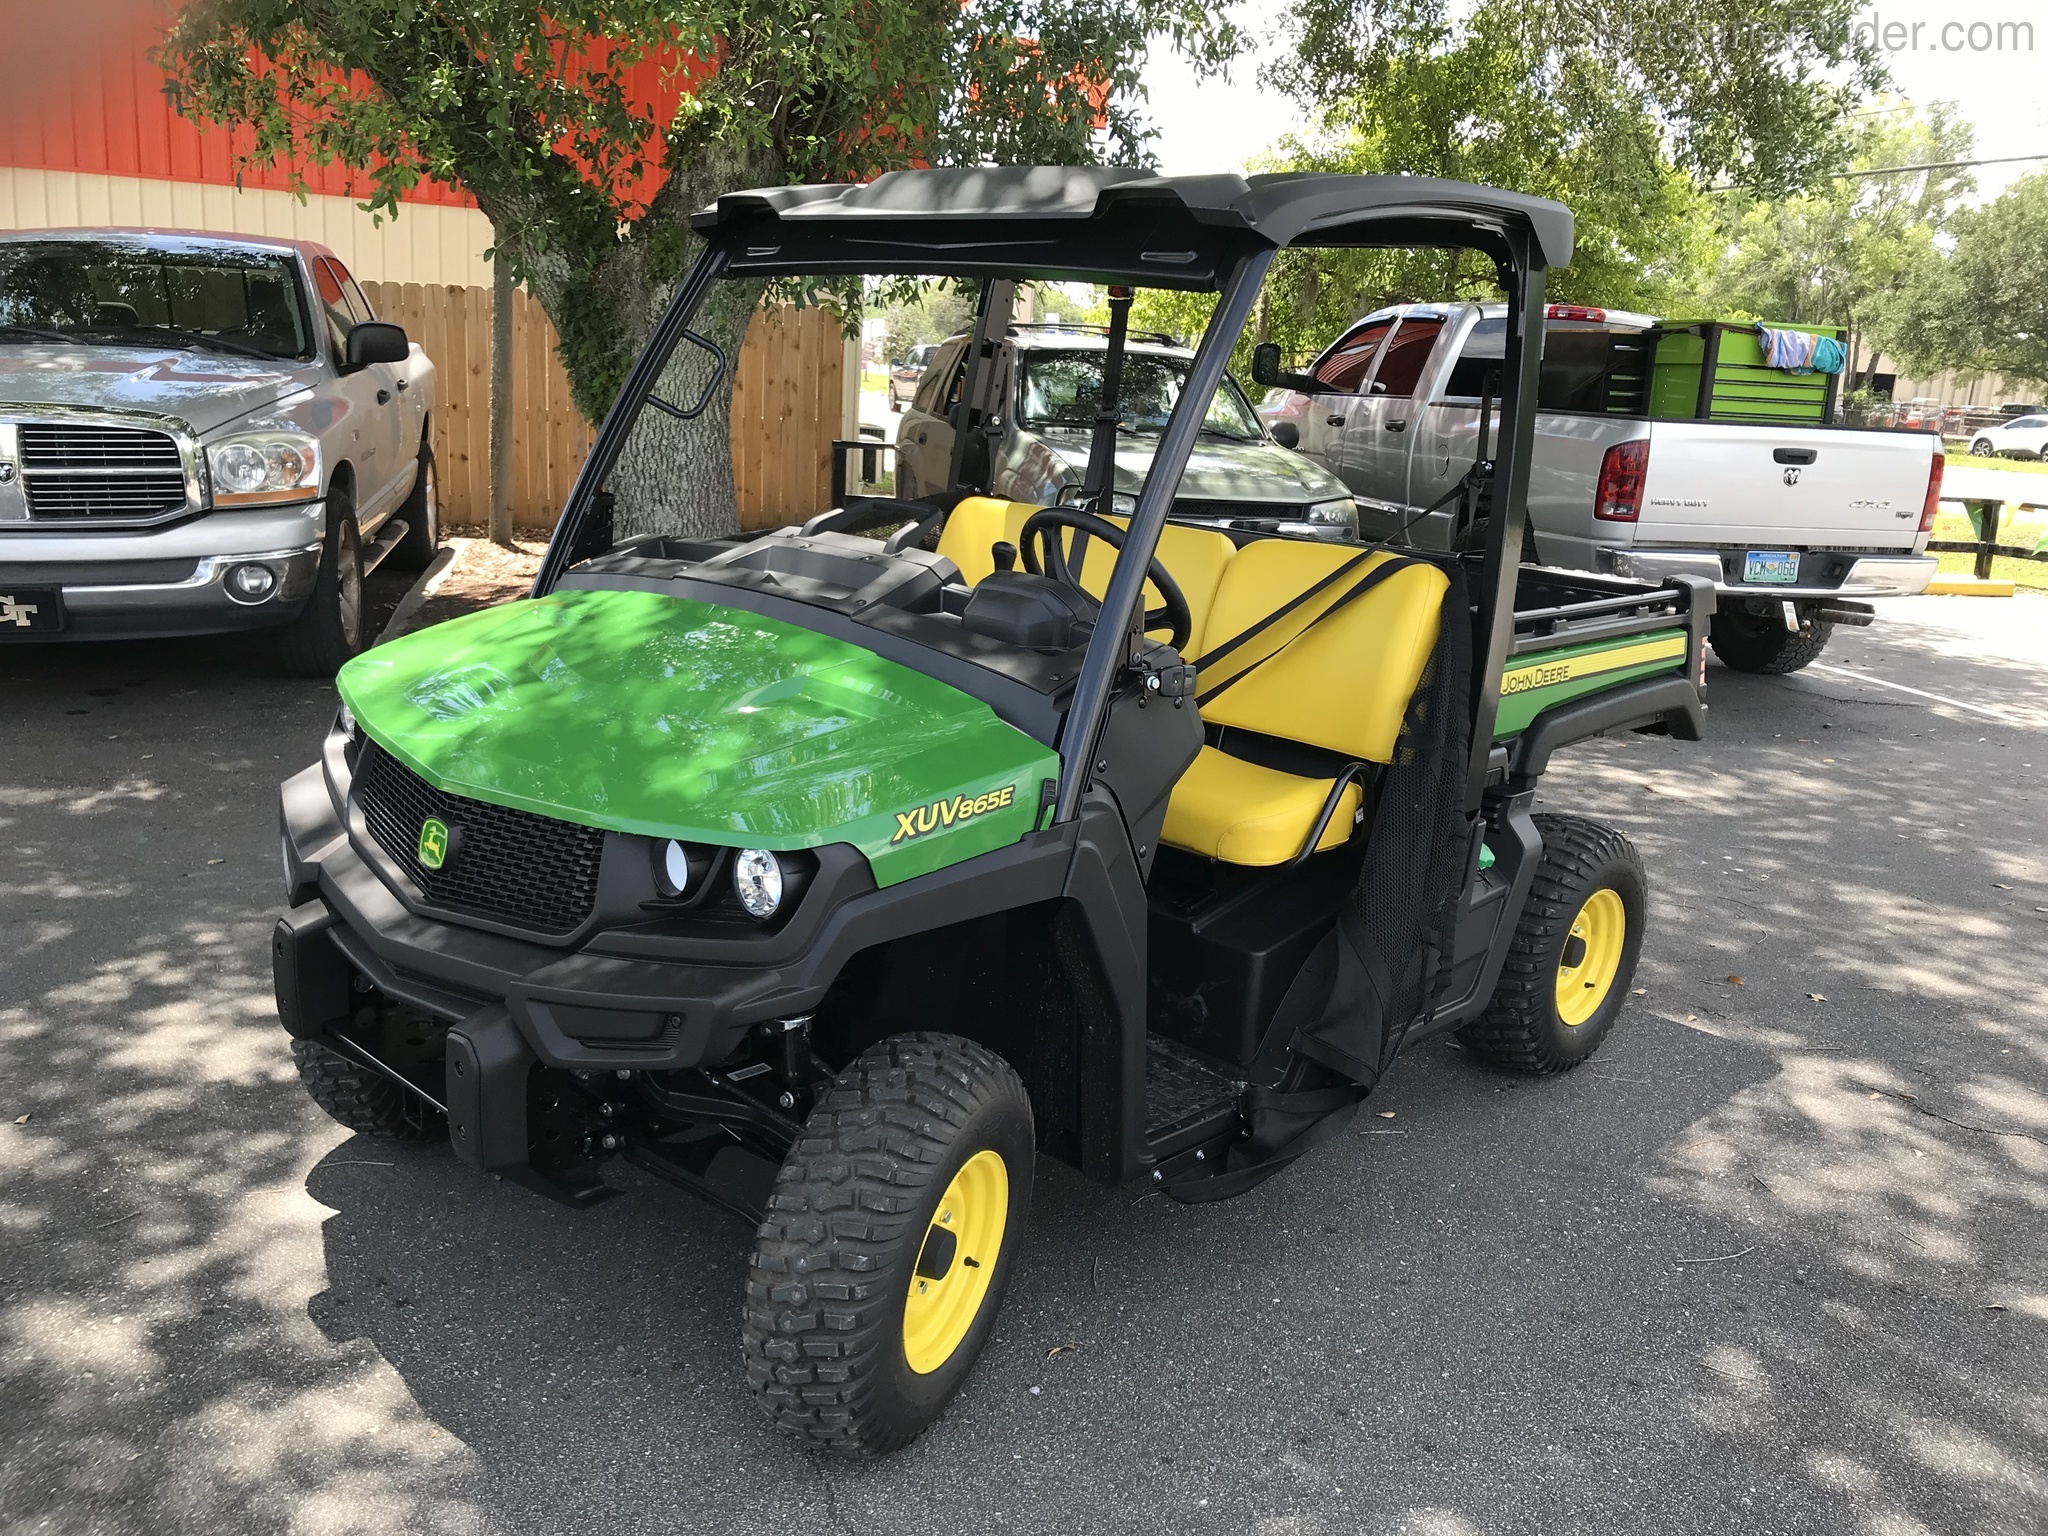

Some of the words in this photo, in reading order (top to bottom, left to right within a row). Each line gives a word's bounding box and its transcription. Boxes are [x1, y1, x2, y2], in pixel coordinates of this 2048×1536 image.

[1650, 497, 1683, 507] HEAVY
[1684, 499, 1710, 508] DUTY
[1502, 673, 1533, 693] JOHN
[1534, 665, 1570, 686] DEERE
[890, 784, 1015, 845] XUV865E
